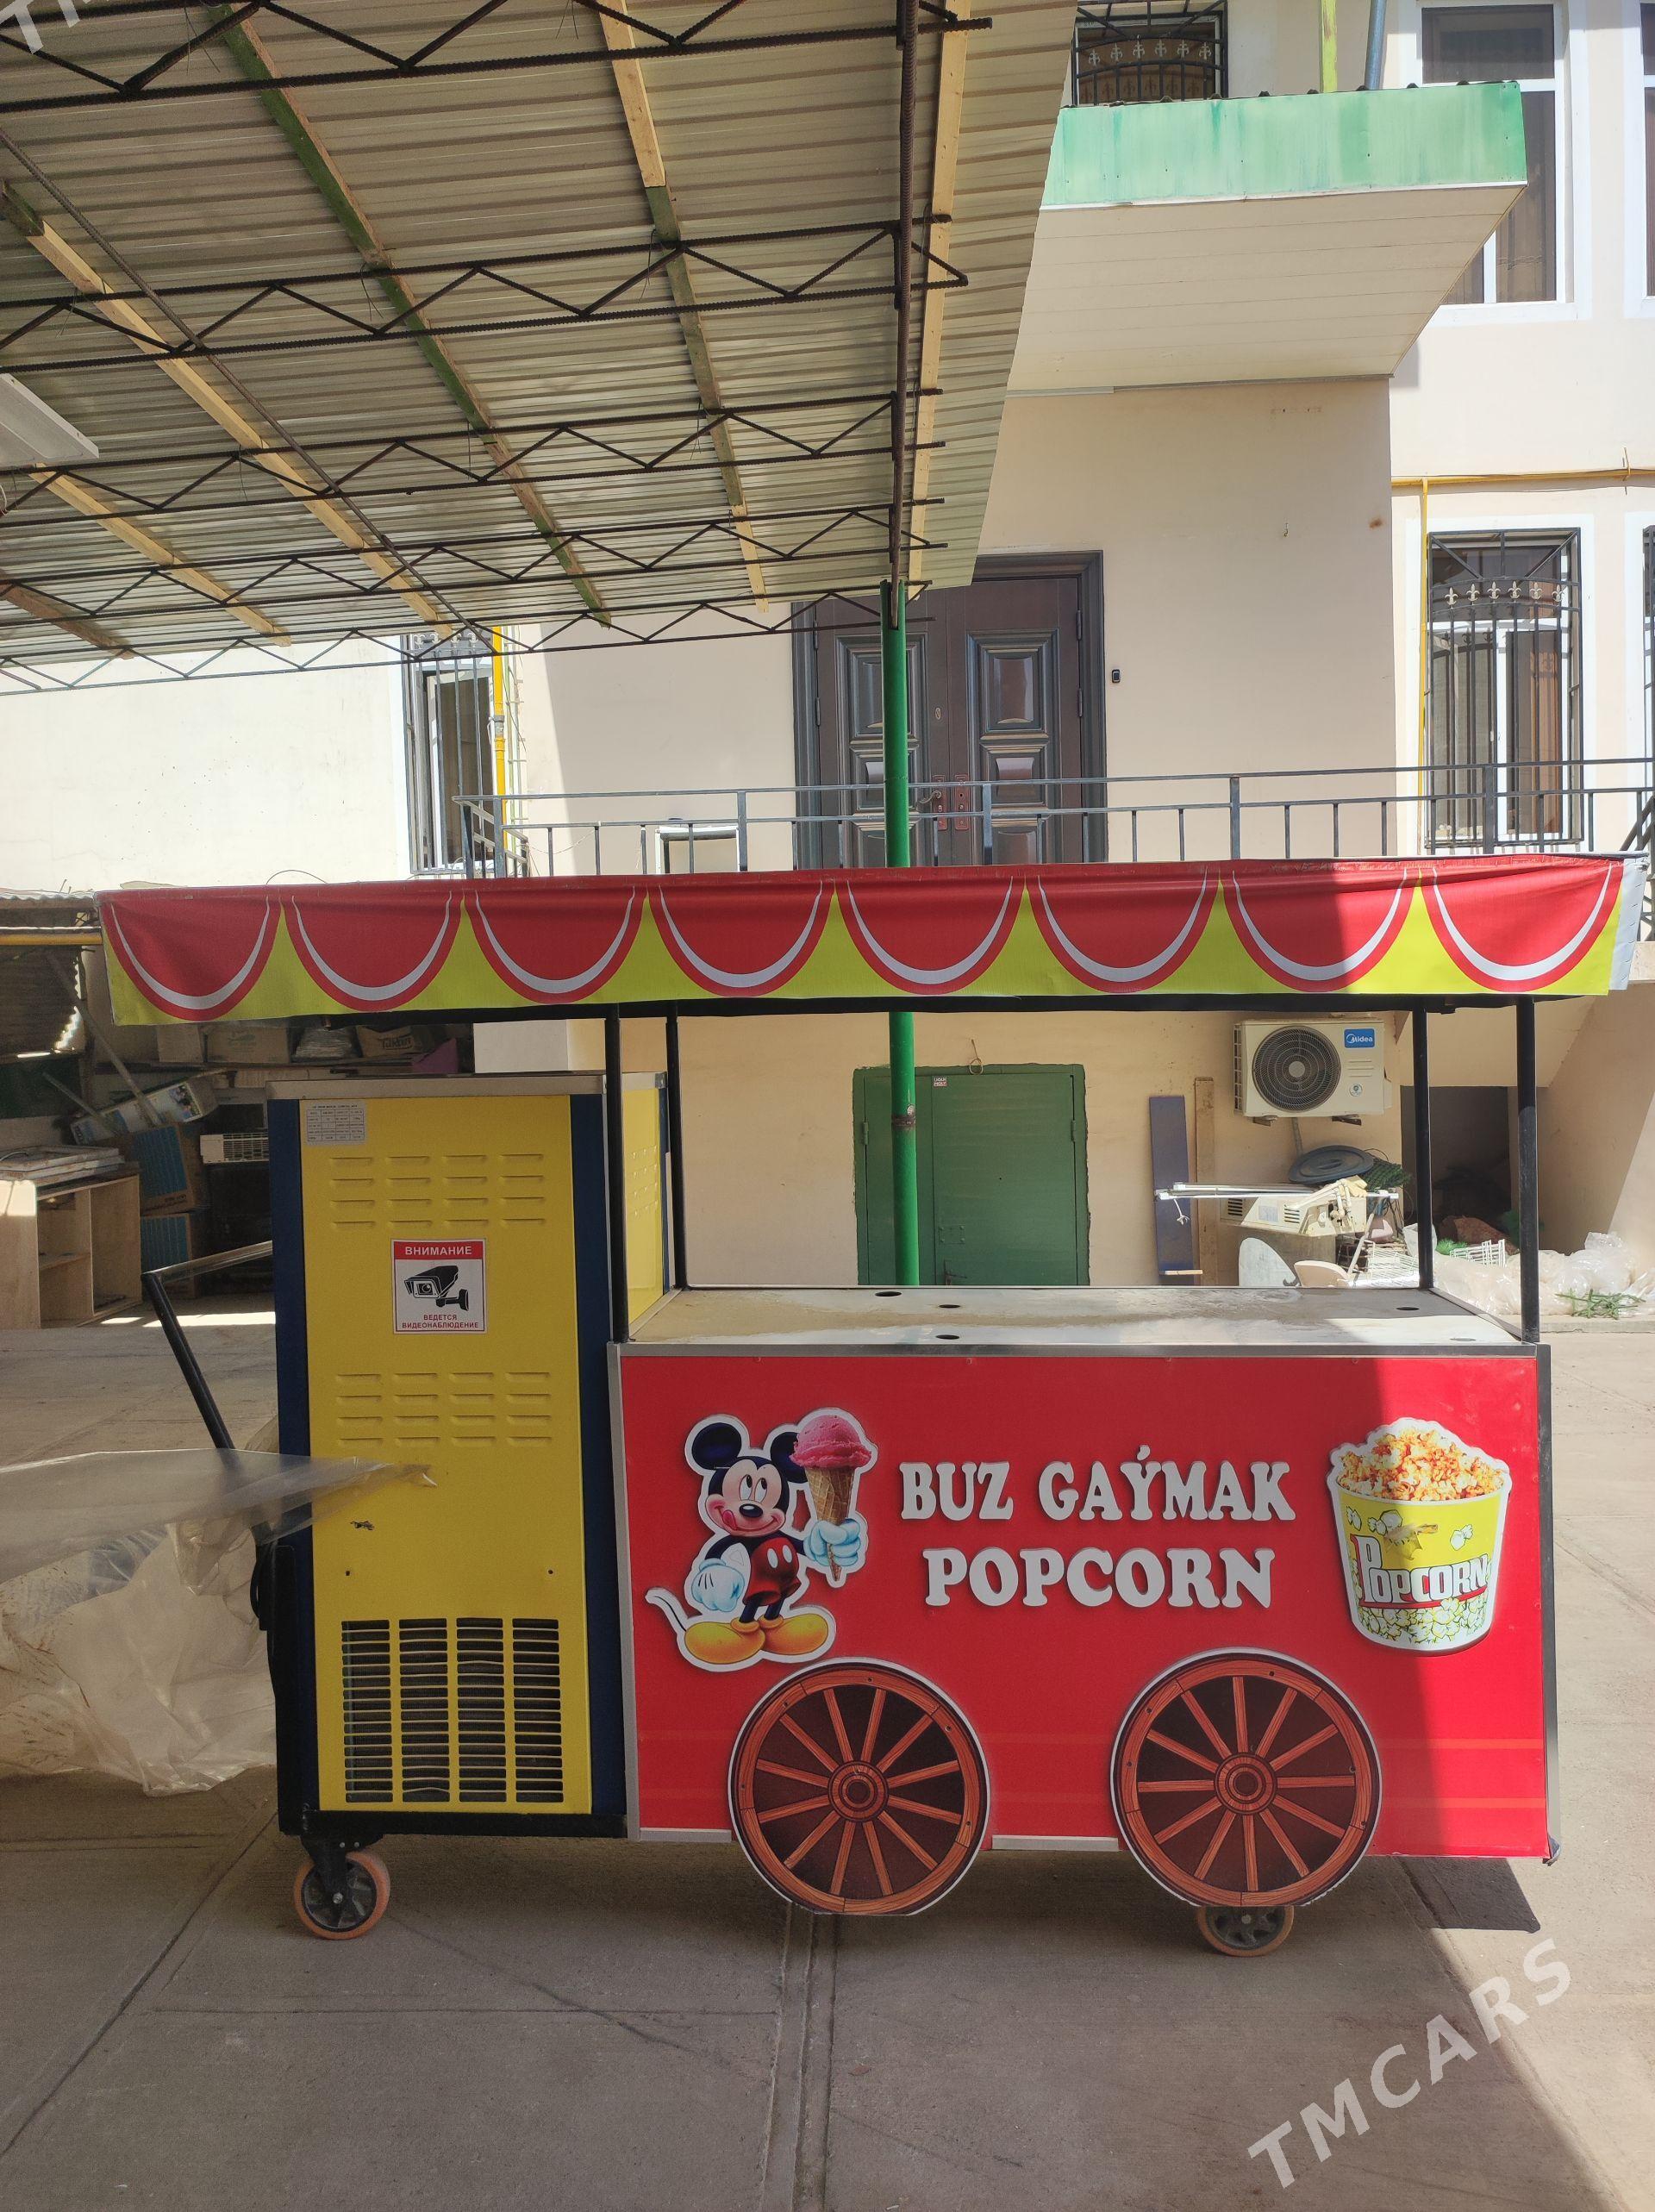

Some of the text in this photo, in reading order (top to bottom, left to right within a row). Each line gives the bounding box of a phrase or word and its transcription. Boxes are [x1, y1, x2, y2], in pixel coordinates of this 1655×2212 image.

[1346, 1034, 1373, 1044] Midea
[405, 1246, 472, 1255] ВНИМАНИЕ
[899, 1444, 1296, 1522] BUZ GAÝMAK
[922, 1547, 1276, 1609] POPCORN
